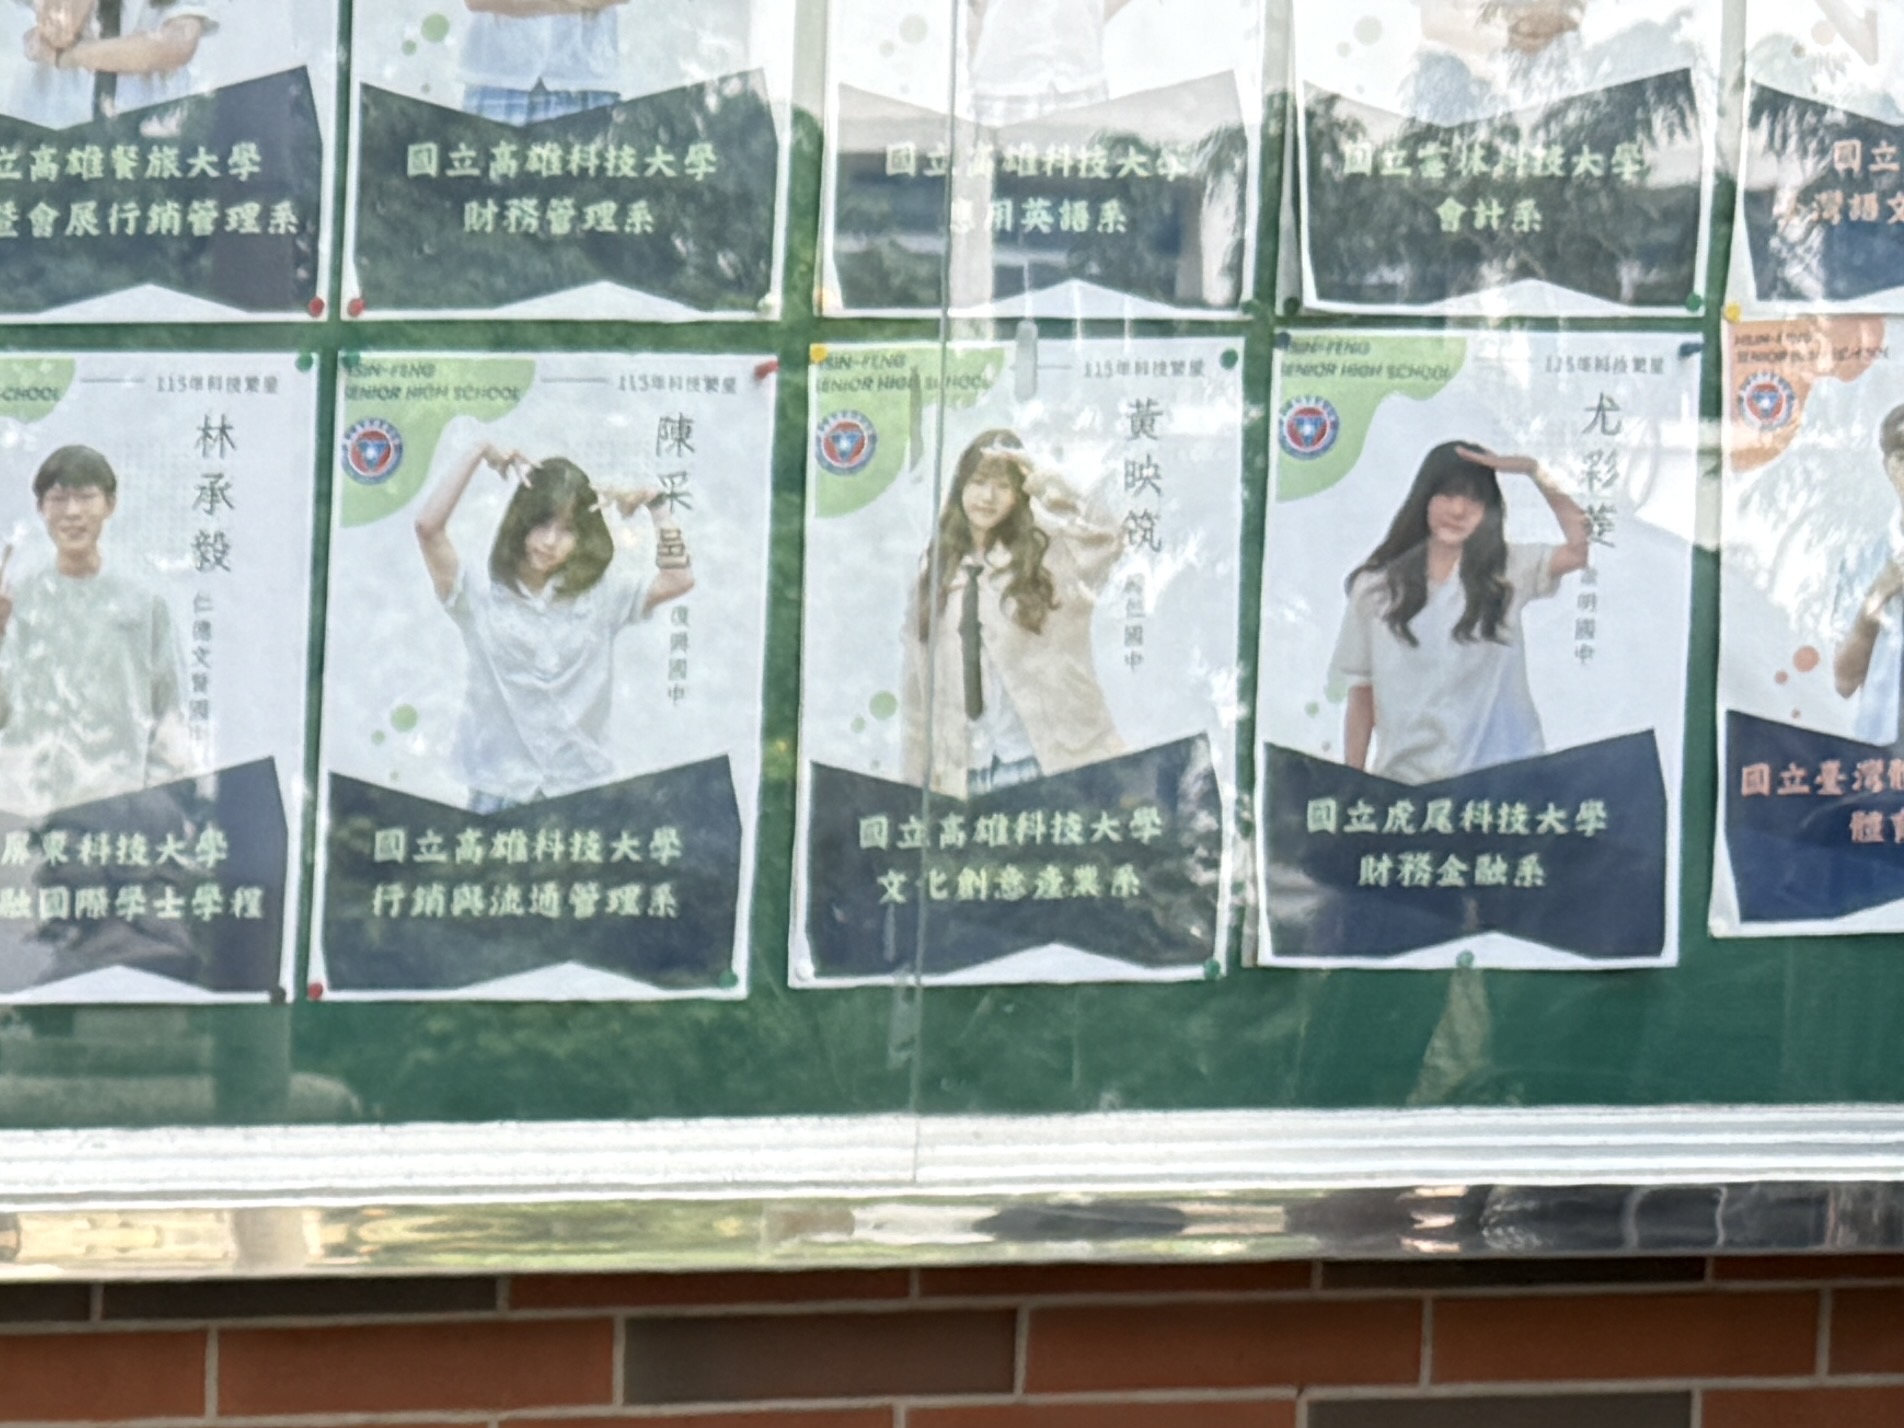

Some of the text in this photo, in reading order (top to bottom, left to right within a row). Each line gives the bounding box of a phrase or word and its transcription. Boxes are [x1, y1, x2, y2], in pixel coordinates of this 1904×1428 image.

[407, 141, 718, 182] 國立高雄科技大學
[463, 198, 655, 236] 財務管理系
[1435, 198, 1542, 233] 會計系
[192, 411, 238, 575] 林承毅
[859, 806, 1163, 850] 國立高雄科技大學
[1306, 798, 1608, 838] 國立虎尾科技大學
[374, 826, 683, 866] 國立高雄科技大學
[877, 863, 1141, 904] 文化創意產業系
[1358, 851, 1547, 888] 財務金融系
[372, 882, 679, 919] 行銷與流通管理系
